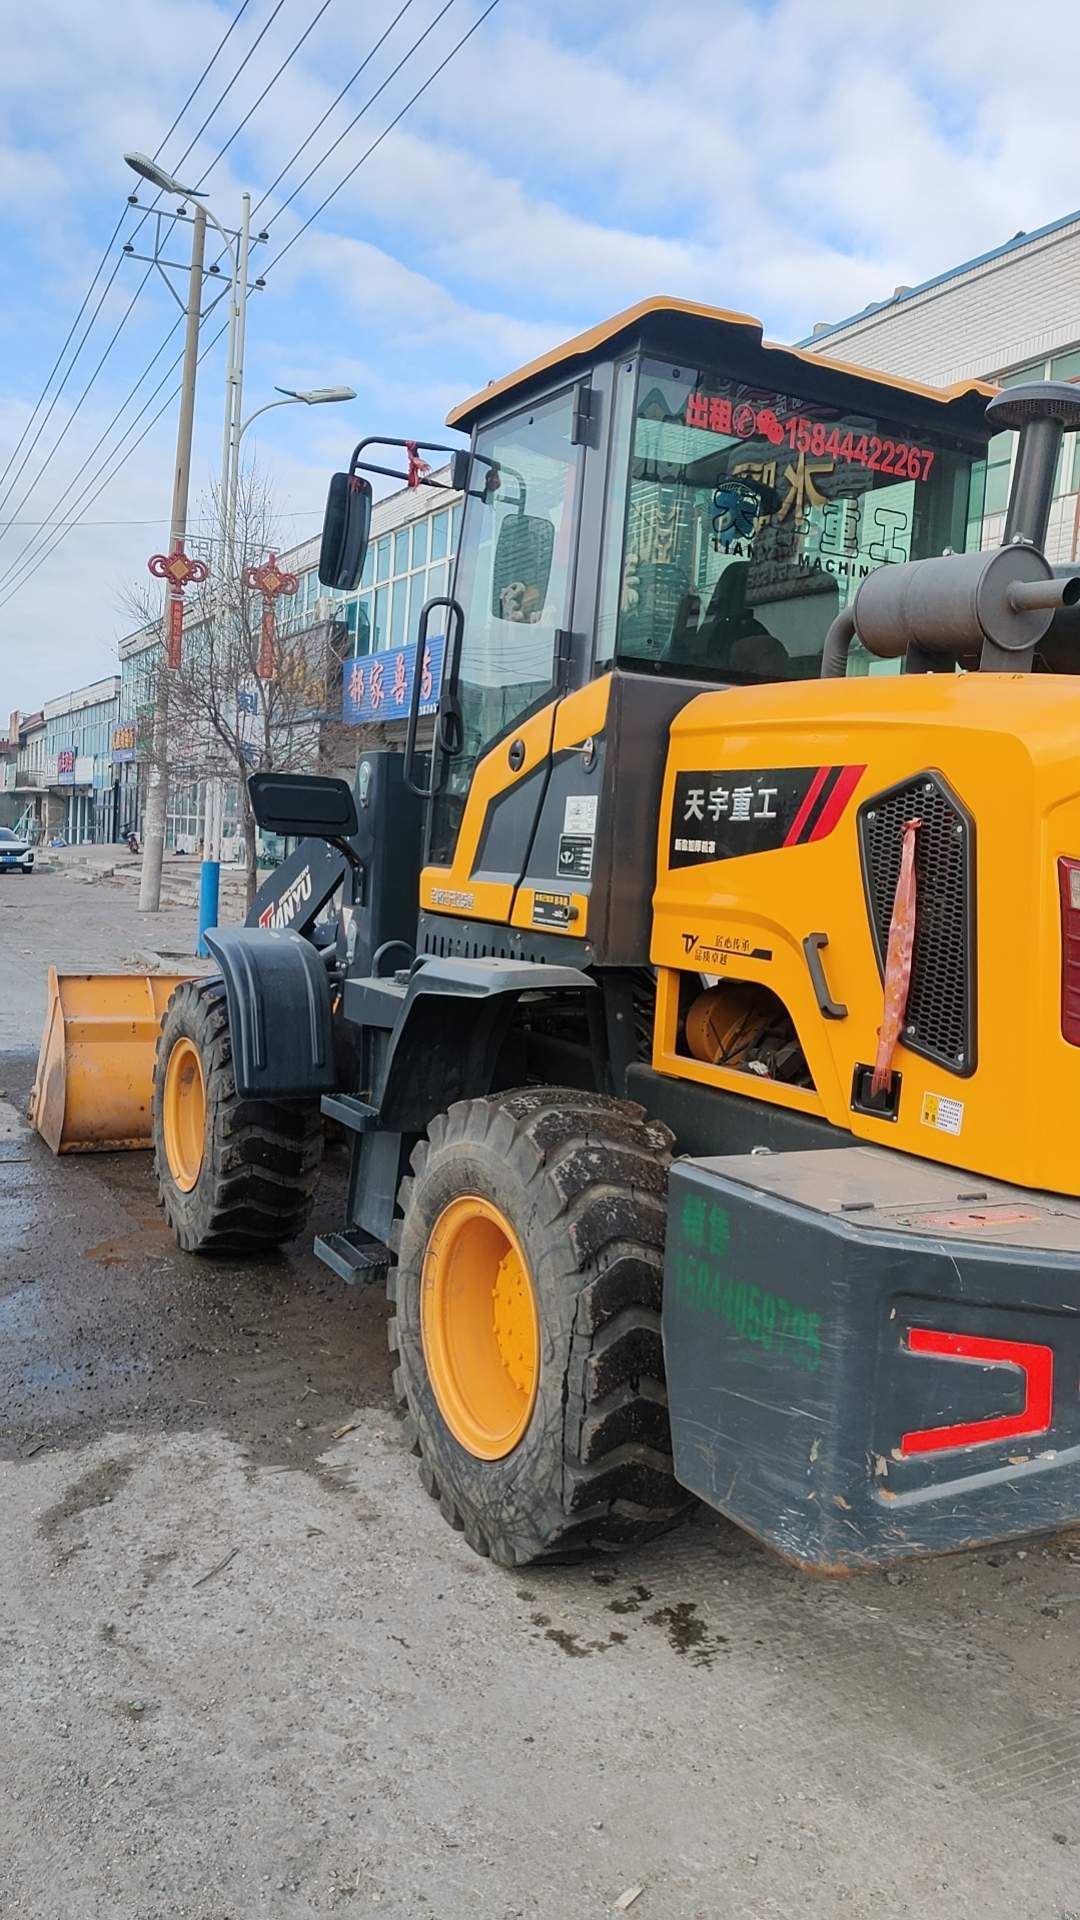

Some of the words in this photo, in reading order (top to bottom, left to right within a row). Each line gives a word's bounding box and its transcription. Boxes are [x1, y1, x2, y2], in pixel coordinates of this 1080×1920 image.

[685, 392, 733, 434] 出租
[784, 415, 936, 482] 15844422267
[712, 488, 908, 564] 天重工
[683, 785, 778, 822] 天宇重工
